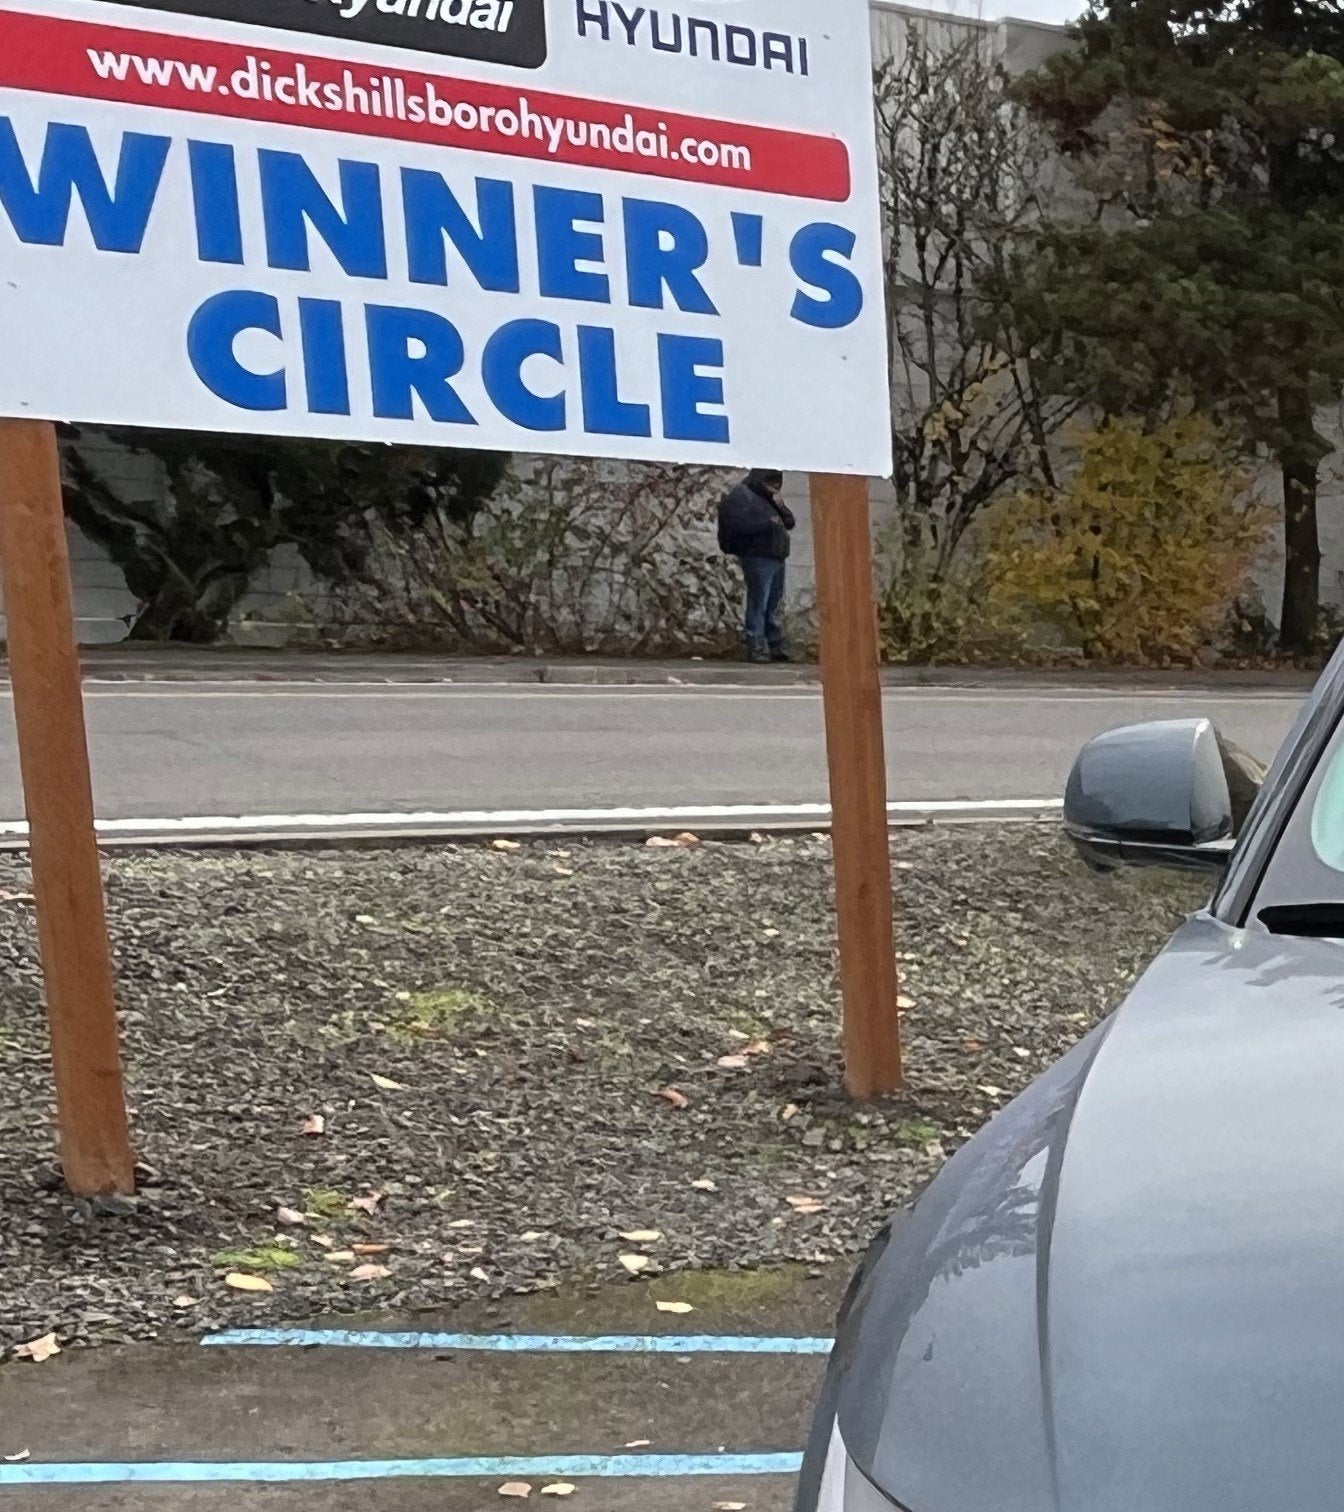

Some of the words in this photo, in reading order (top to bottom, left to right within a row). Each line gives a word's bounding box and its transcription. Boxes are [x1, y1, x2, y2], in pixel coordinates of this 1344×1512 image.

[578, 0, 809, 76] HYUNDAI
[86, 46, 752, 172] www.dickshillsborohyundai.com
[0, 115, 864, 329] WINNER'S
[187, 290, 730, 444] CIRCLE
